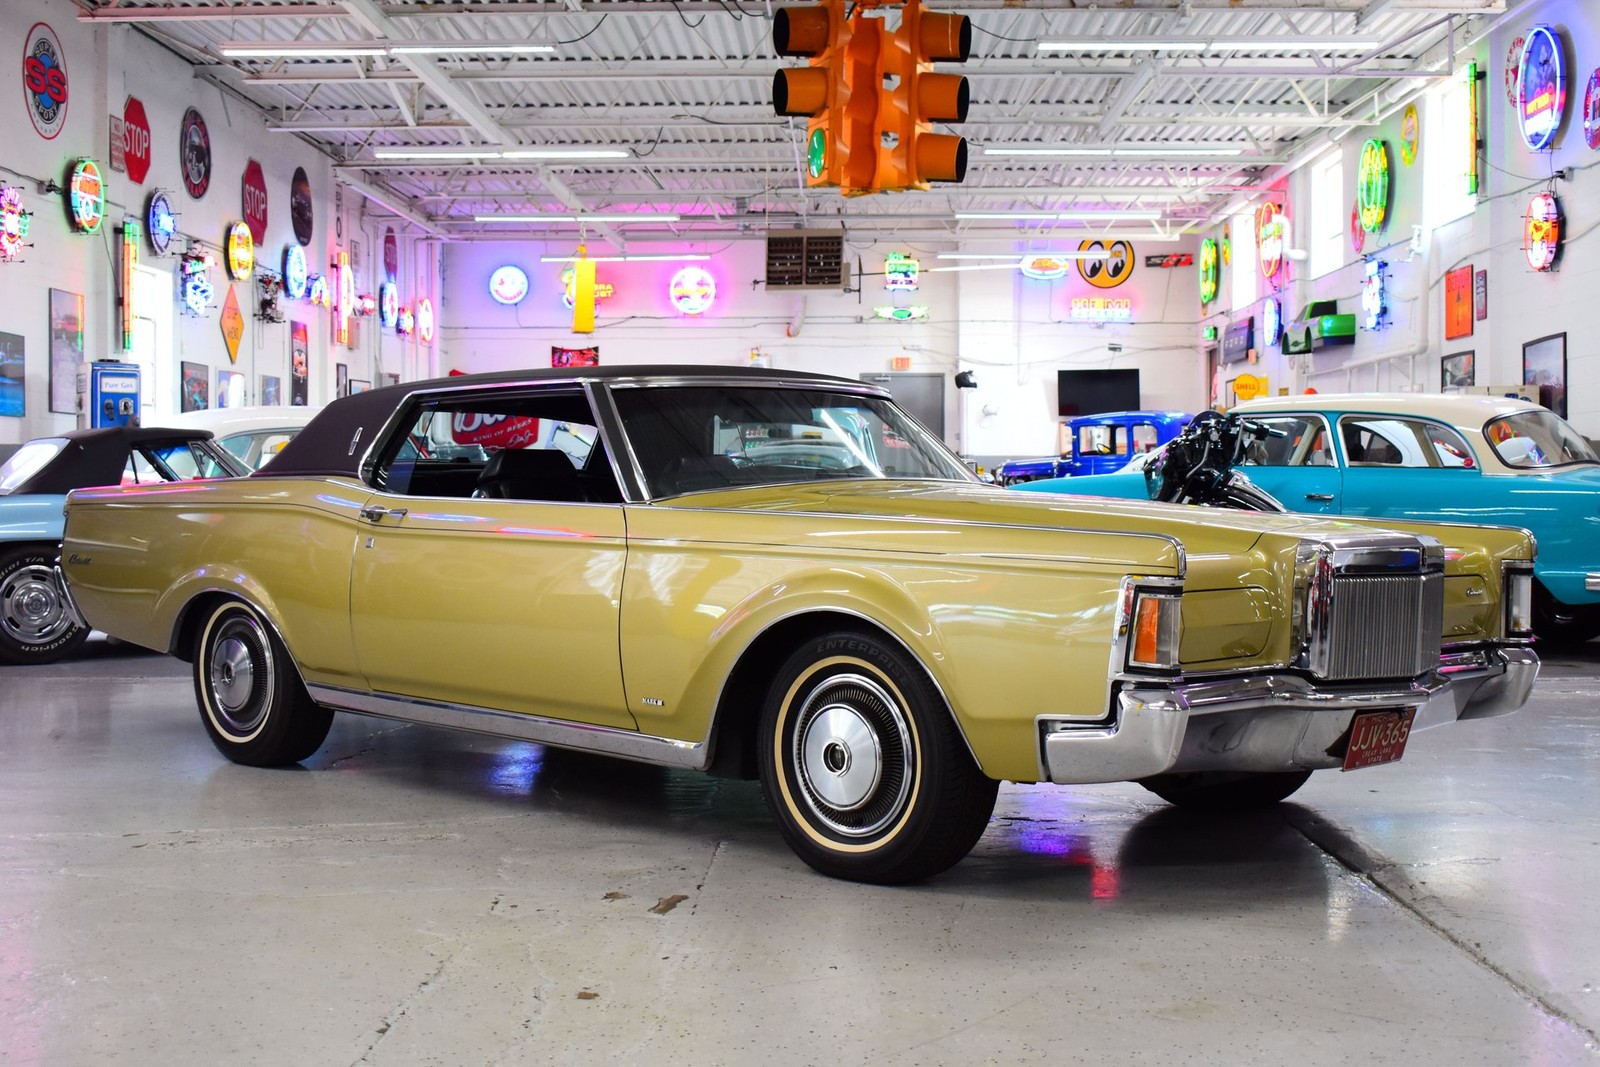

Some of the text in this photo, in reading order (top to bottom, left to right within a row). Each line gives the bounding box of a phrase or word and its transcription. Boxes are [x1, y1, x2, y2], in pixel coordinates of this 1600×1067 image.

[26, 56, 67, 104] SS
[124, 121, 149, 160] STOP
[245, 184, 266, 221] STOP
[473, 433, 492, 442] KING
[506, 418, 533, 433] BEERS
